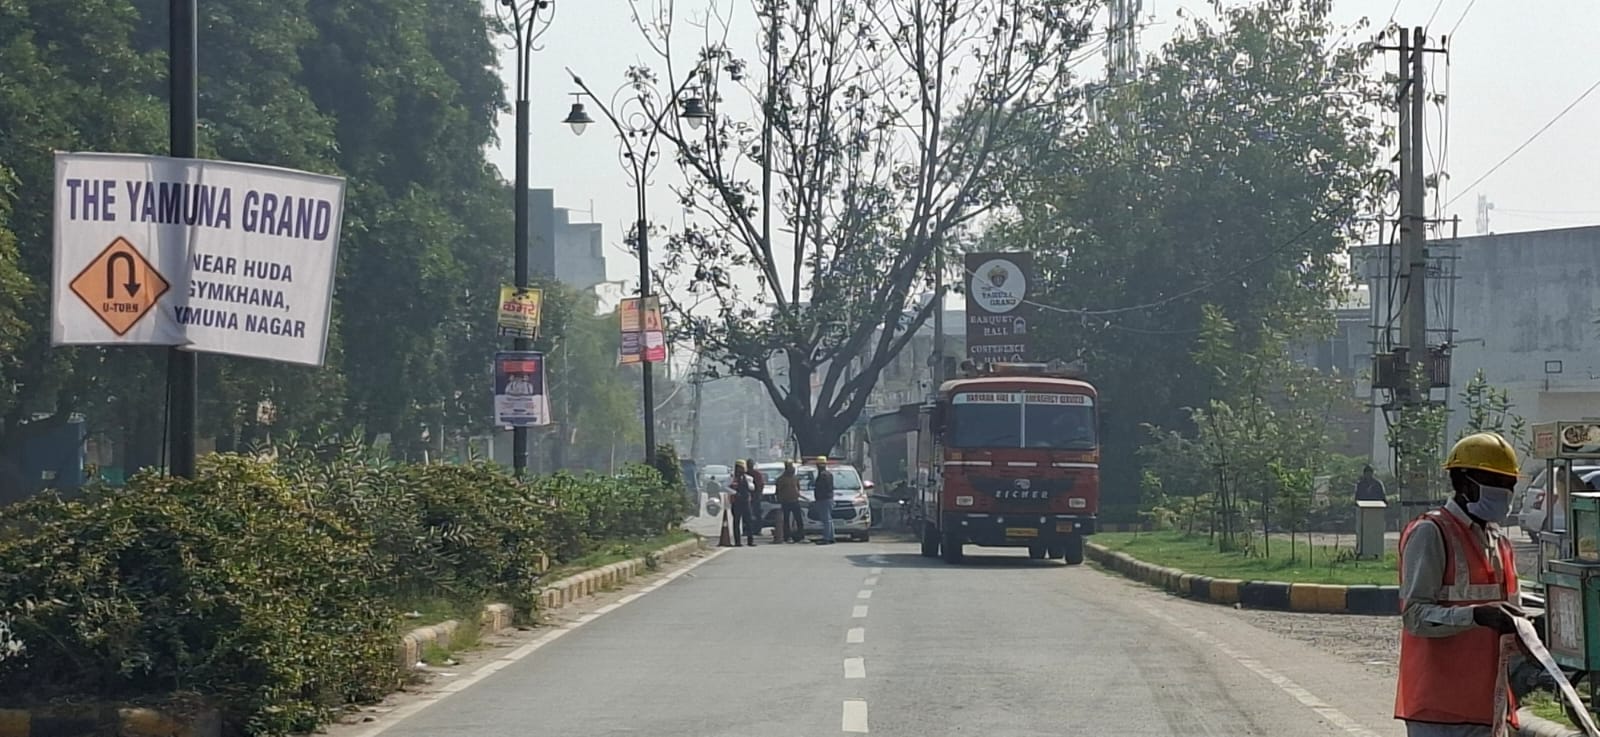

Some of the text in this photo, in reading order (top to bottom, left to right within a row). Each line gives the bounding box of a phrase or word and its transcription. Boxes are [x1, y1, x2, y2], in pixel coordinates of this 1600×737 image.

[66, 178, 333, 241] THE YAMUNA GRAND
[193, 253, 293, 283] NEAR HUDA
[188, 279, 291, 312] GYMKHANA,
[102, 302, 138, 313] U-TURN
[174, 305, 306, 338] YAMUNA NAGAR
[970, 315, 1014, 325] BANQUET
[984, 327, 1009, 336] HALL
[970, 344, 1026, 353] CONFERENCE
[995, 490, 1049, 498] EICHER
